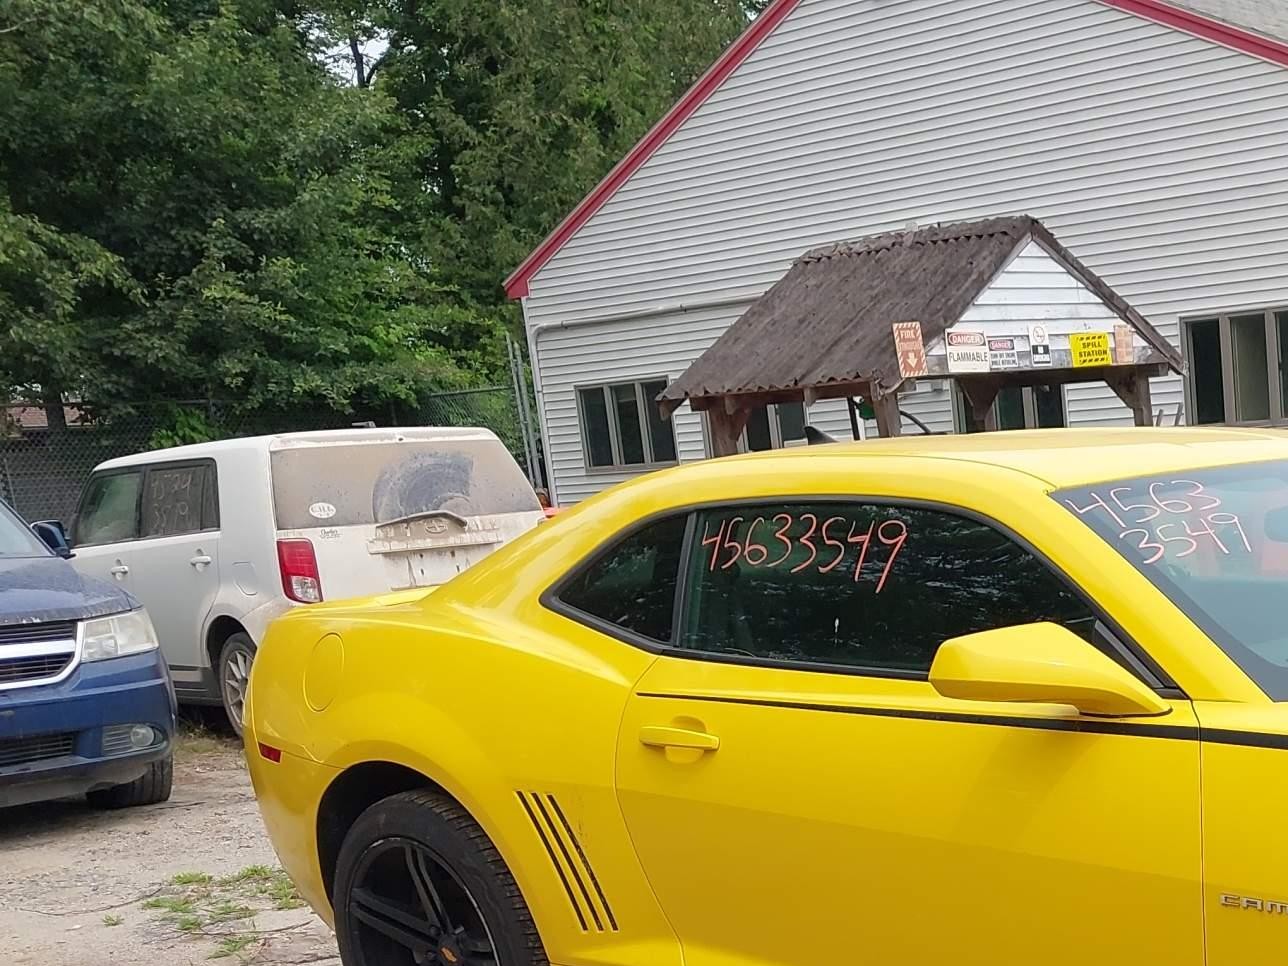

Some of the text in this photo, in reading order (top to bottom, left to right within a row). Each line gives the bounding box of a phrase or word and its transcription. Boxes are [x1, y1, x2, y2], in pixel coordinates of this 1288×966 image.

[952, 335, 980, 343] DANGER
[1079, 349, 1107, 357] STATION
[949, 351, 988, 361] FLAMMABLE
[1065, 480, 1221, 527] 4563
[1120, 513, 1251, 563] 3549
[702, 514, 907, 593] 45633549
